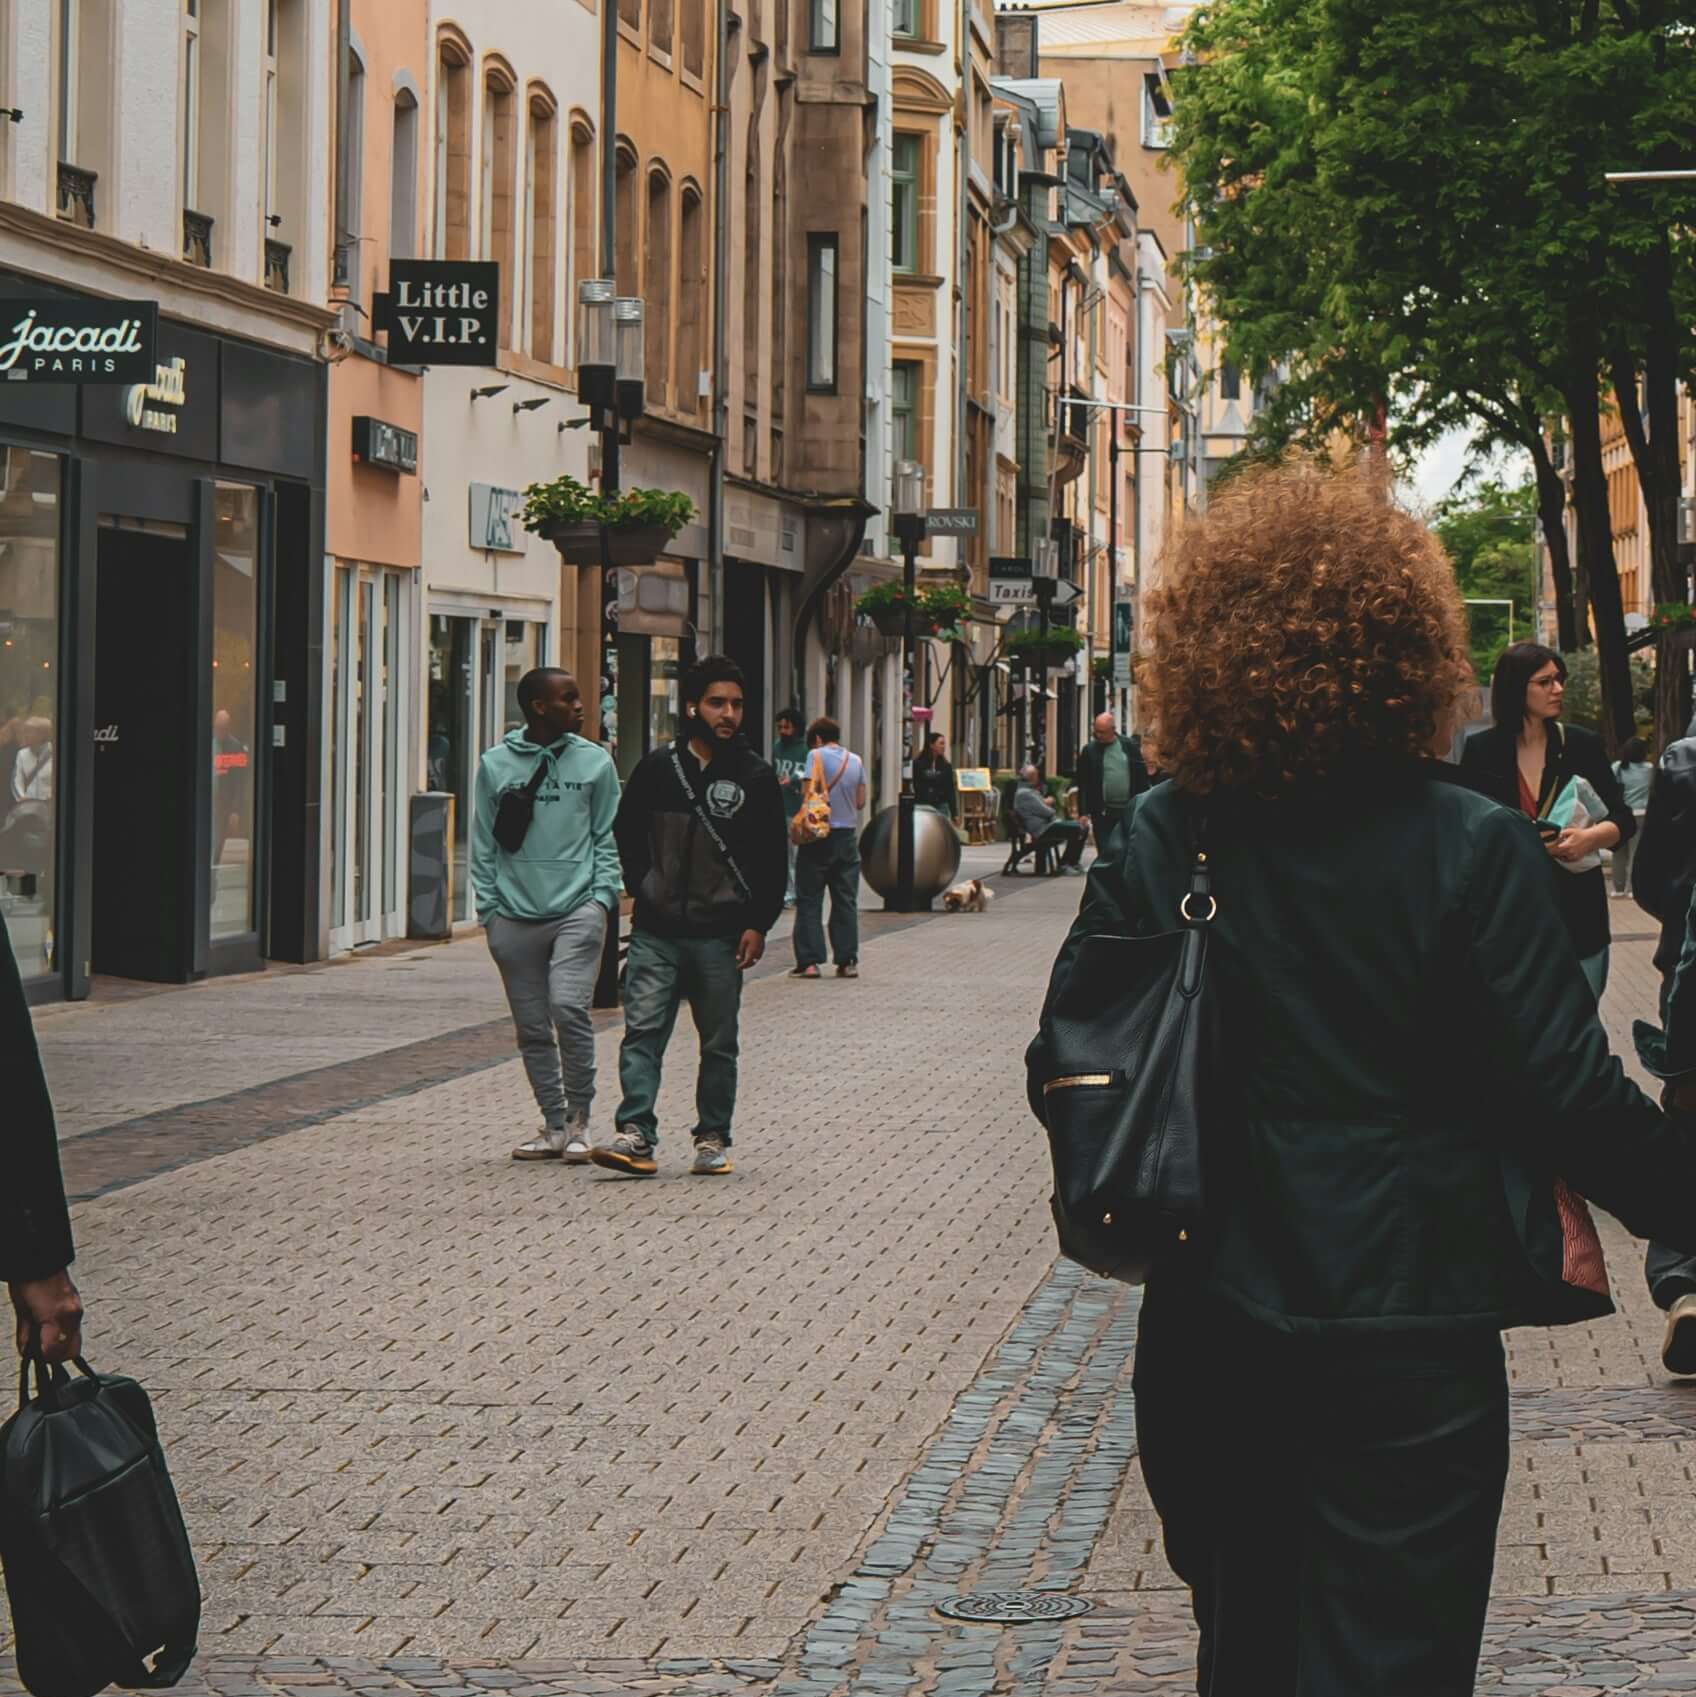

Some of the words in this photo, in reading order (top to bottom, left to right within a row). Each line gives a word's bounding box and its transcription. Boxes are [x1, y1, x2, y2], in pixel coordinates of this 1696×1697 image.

[397, 280, 489, 310] Little
[0, 309, 142, 371] jacadi
[397, 315, 487, 345] V.I.P.
[34, 357, 116, 373] PARIS
[926, 515, 976, 529] ROVSKI
[994, 584, 1034, 599] Taxis
